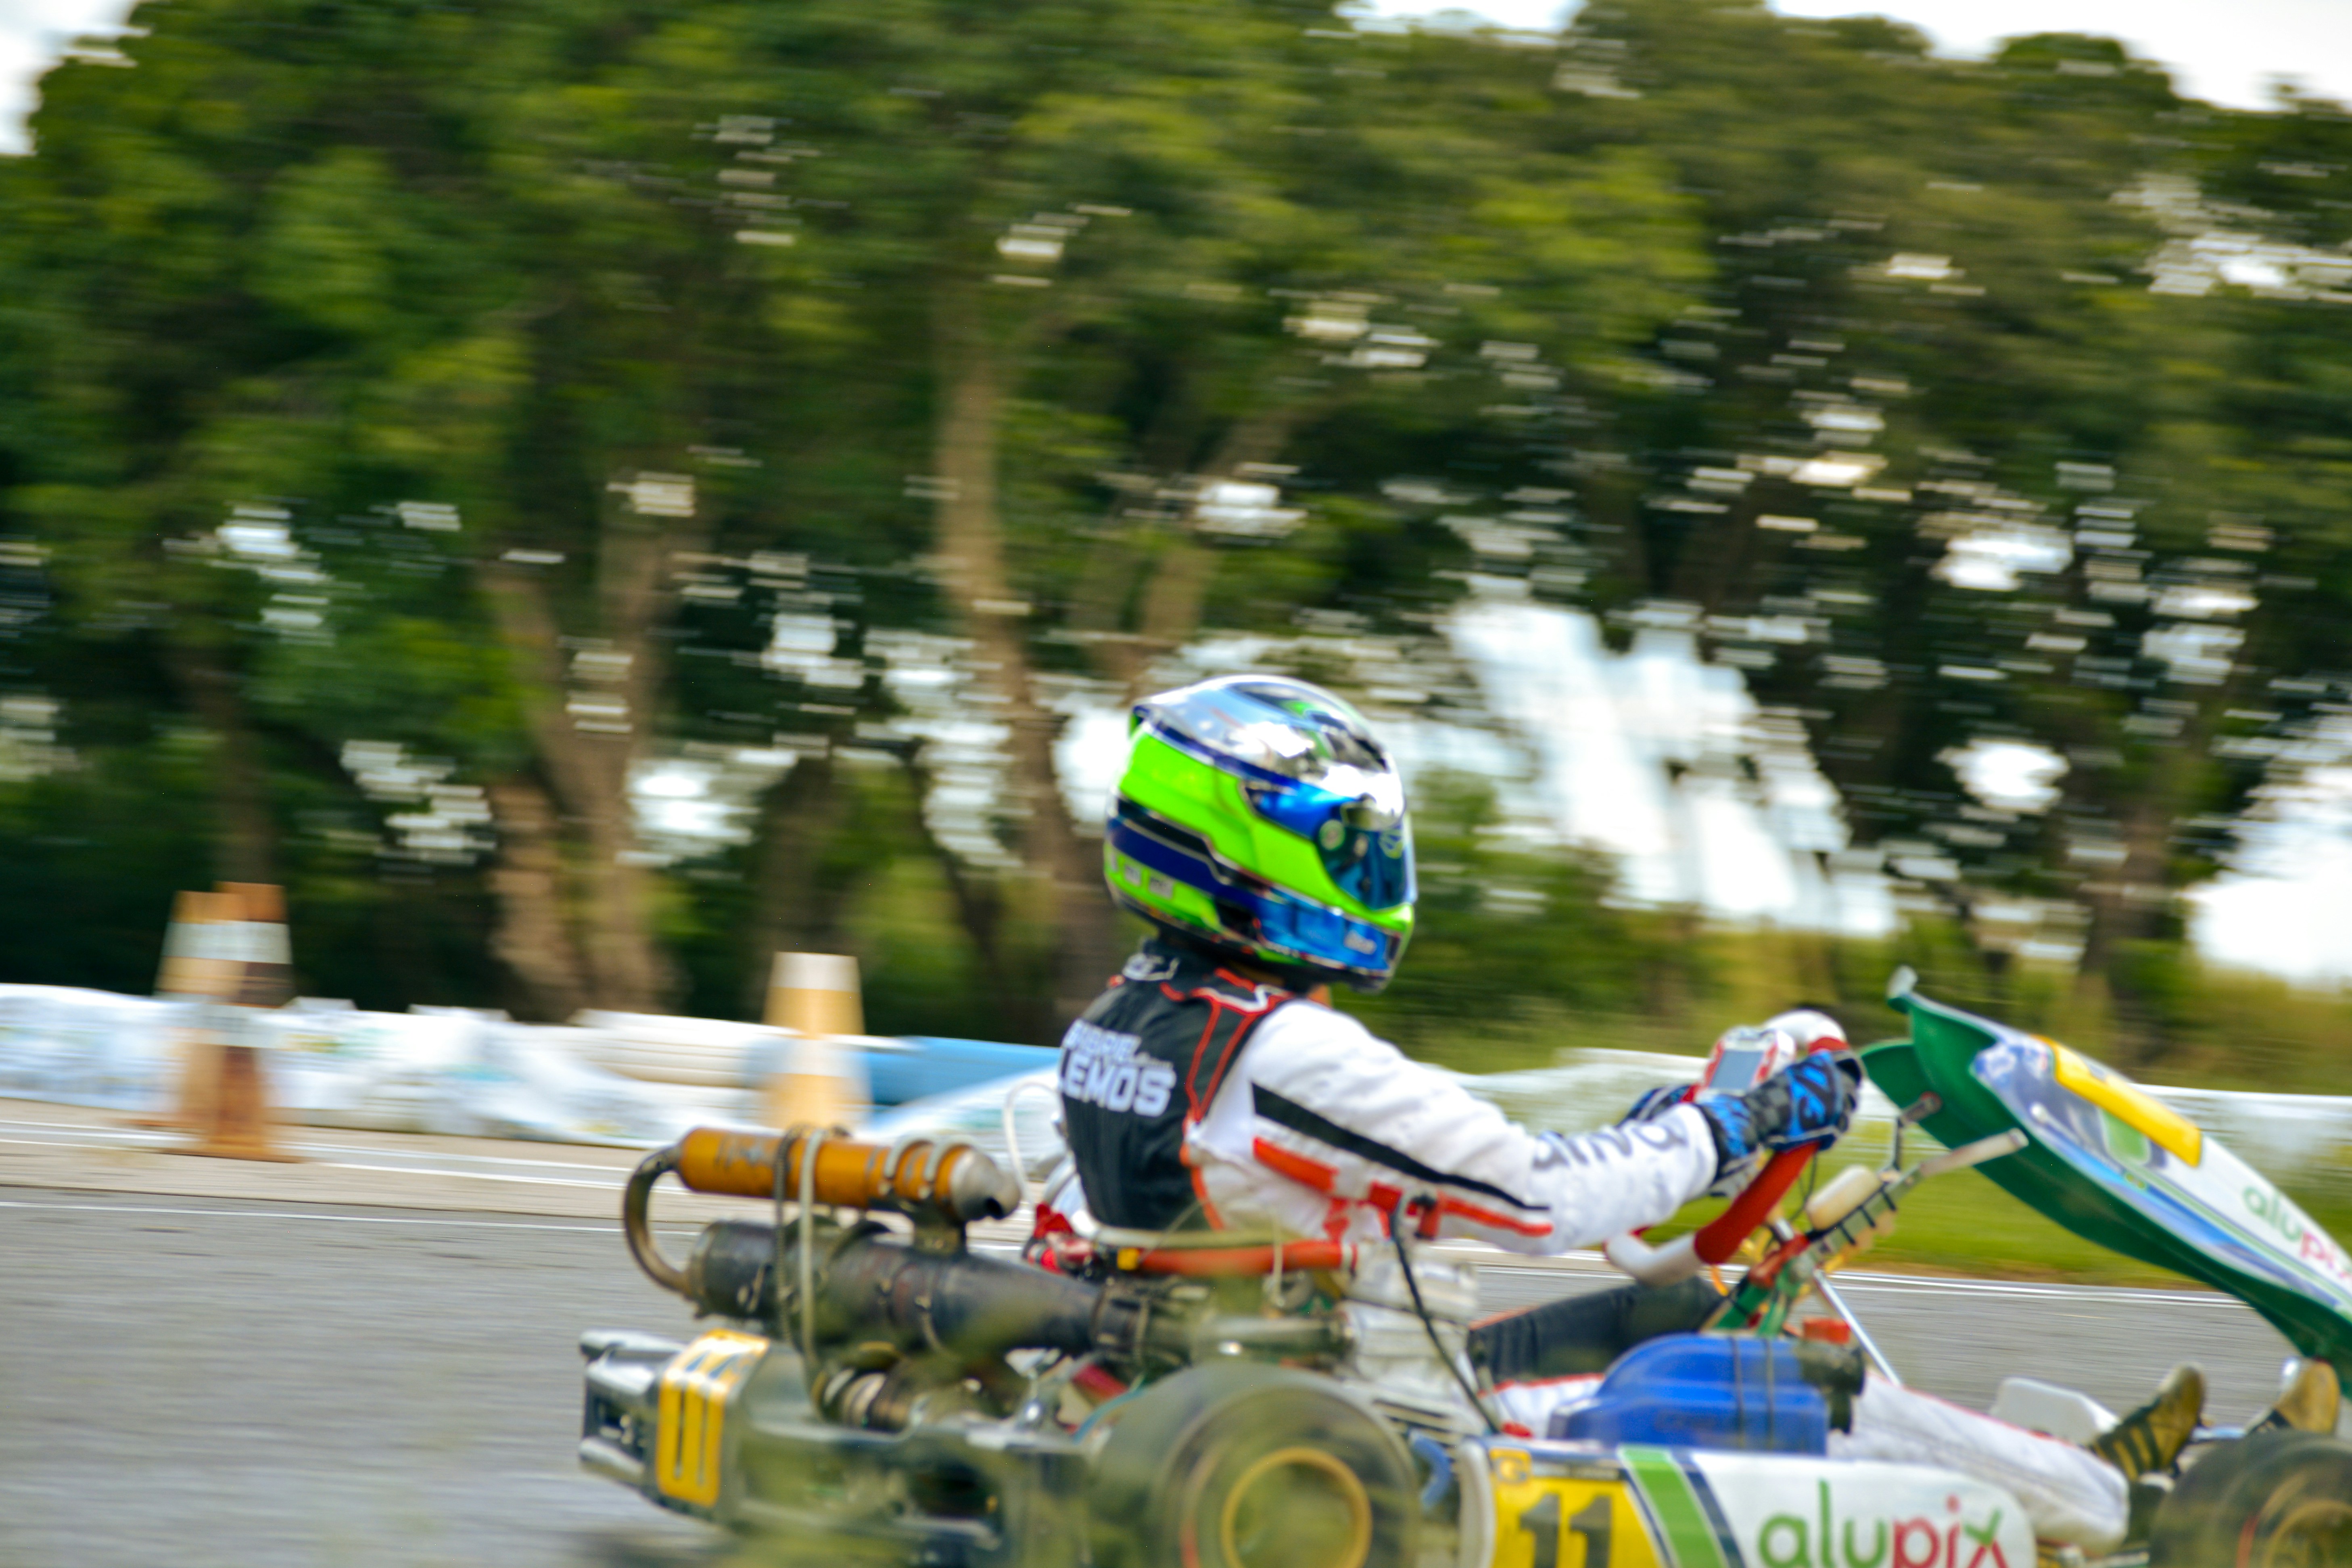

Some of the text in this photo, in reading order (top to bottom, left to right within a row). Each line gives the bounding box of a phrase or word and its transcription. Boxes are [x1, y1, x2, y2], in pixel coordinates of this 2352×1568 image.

[2242, 1185, 2352, 1279] alupi
[1519, 1493, 1612, 1568] 11
[1757, 1476, 2009, 1568] alupix
